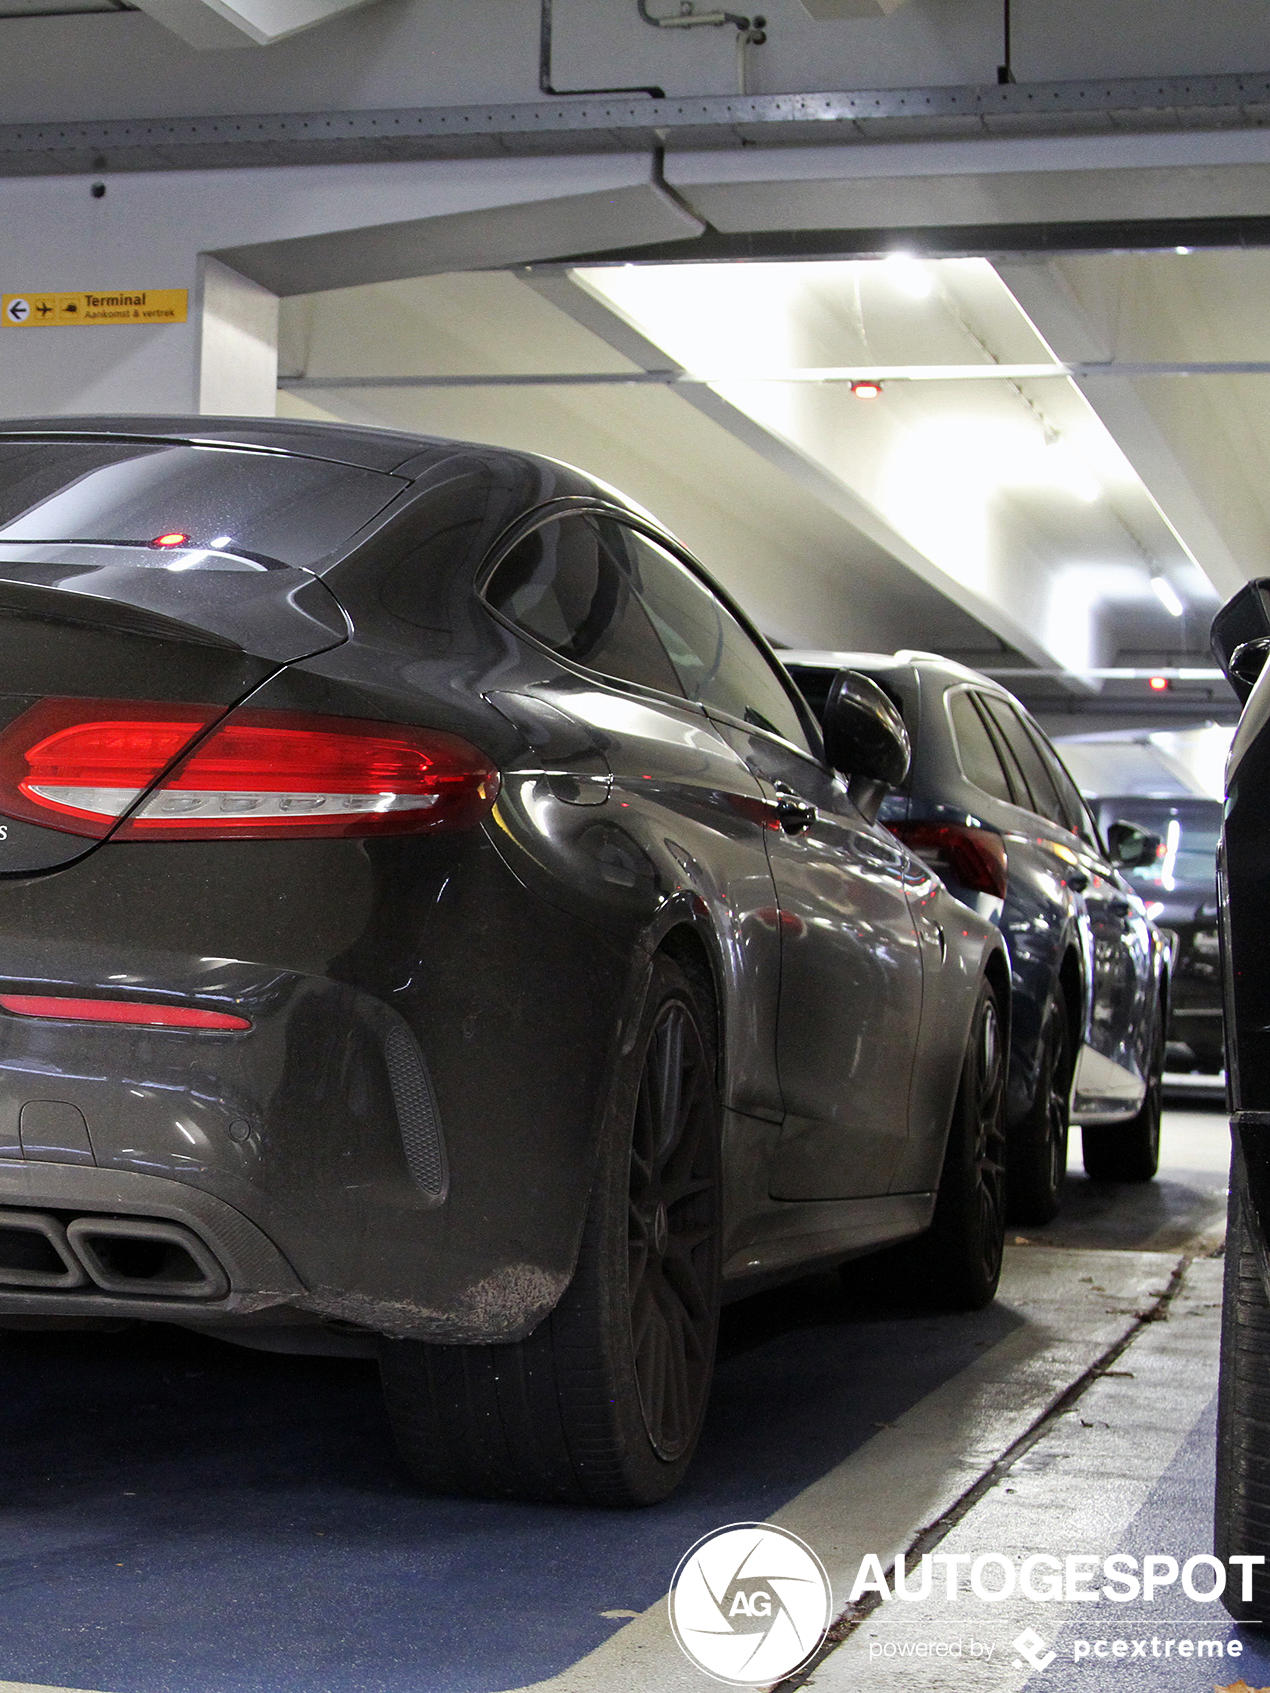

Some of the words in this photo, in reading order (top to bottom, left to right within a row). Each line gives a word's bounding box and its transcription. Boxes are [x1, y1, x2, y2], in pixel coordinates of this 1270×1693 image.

[85, 293, 146, 307] Terminal
[85, 310, 130, 318] Aankomst
[133, 309, 139, 317] &
[142, 309, 175, 317] vertrek
